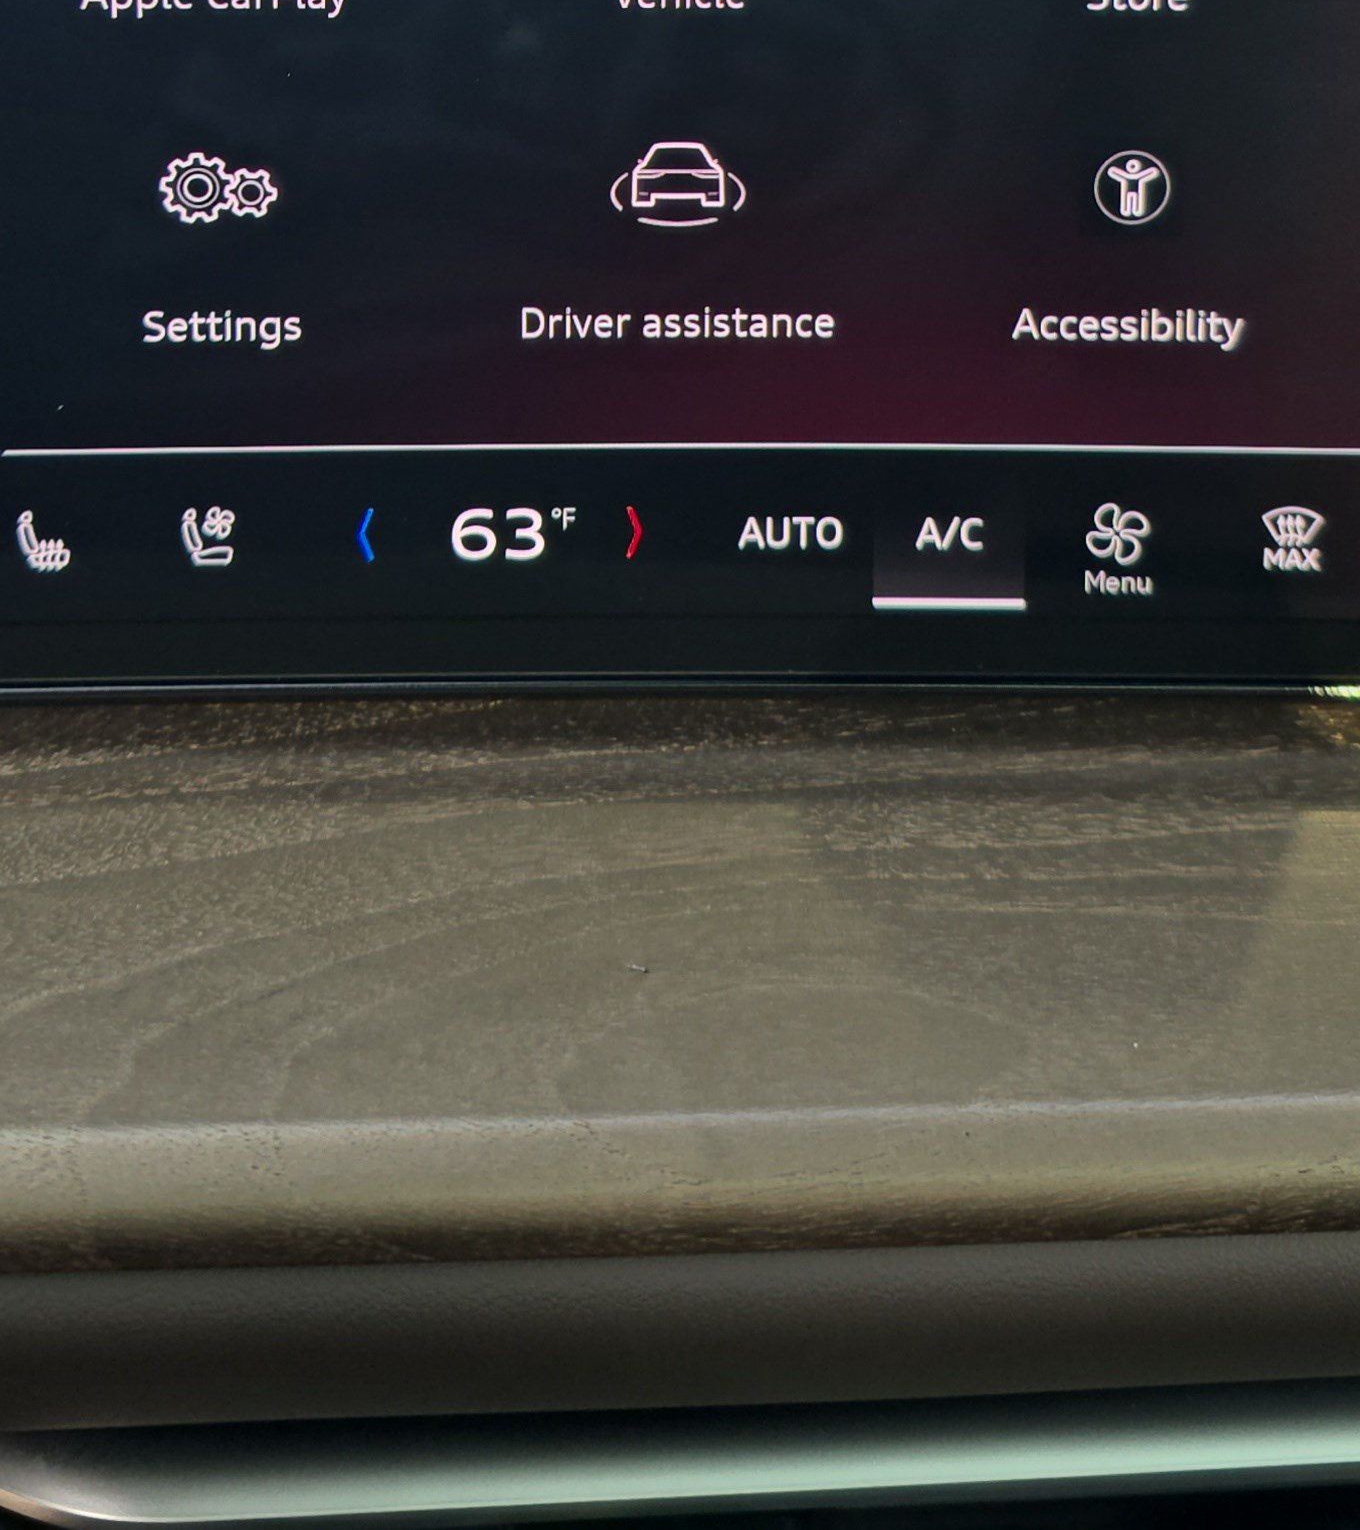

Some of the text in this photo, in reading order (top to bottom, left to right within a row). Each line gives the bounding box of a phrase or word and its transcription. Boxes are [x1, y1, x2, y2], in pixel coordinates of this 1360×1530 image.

[142, 309, 302, 350] Settings
[521, 306, 836, 340] Driver assistance
[1011, 307, 1245, 352] Accessibility
[737, 516, 844, 550] AUTO
[915, 516, 984, 551] A/C
[1262, 546, 1323, 572] MAX
[1084, 569, 1153, 595] Menu
